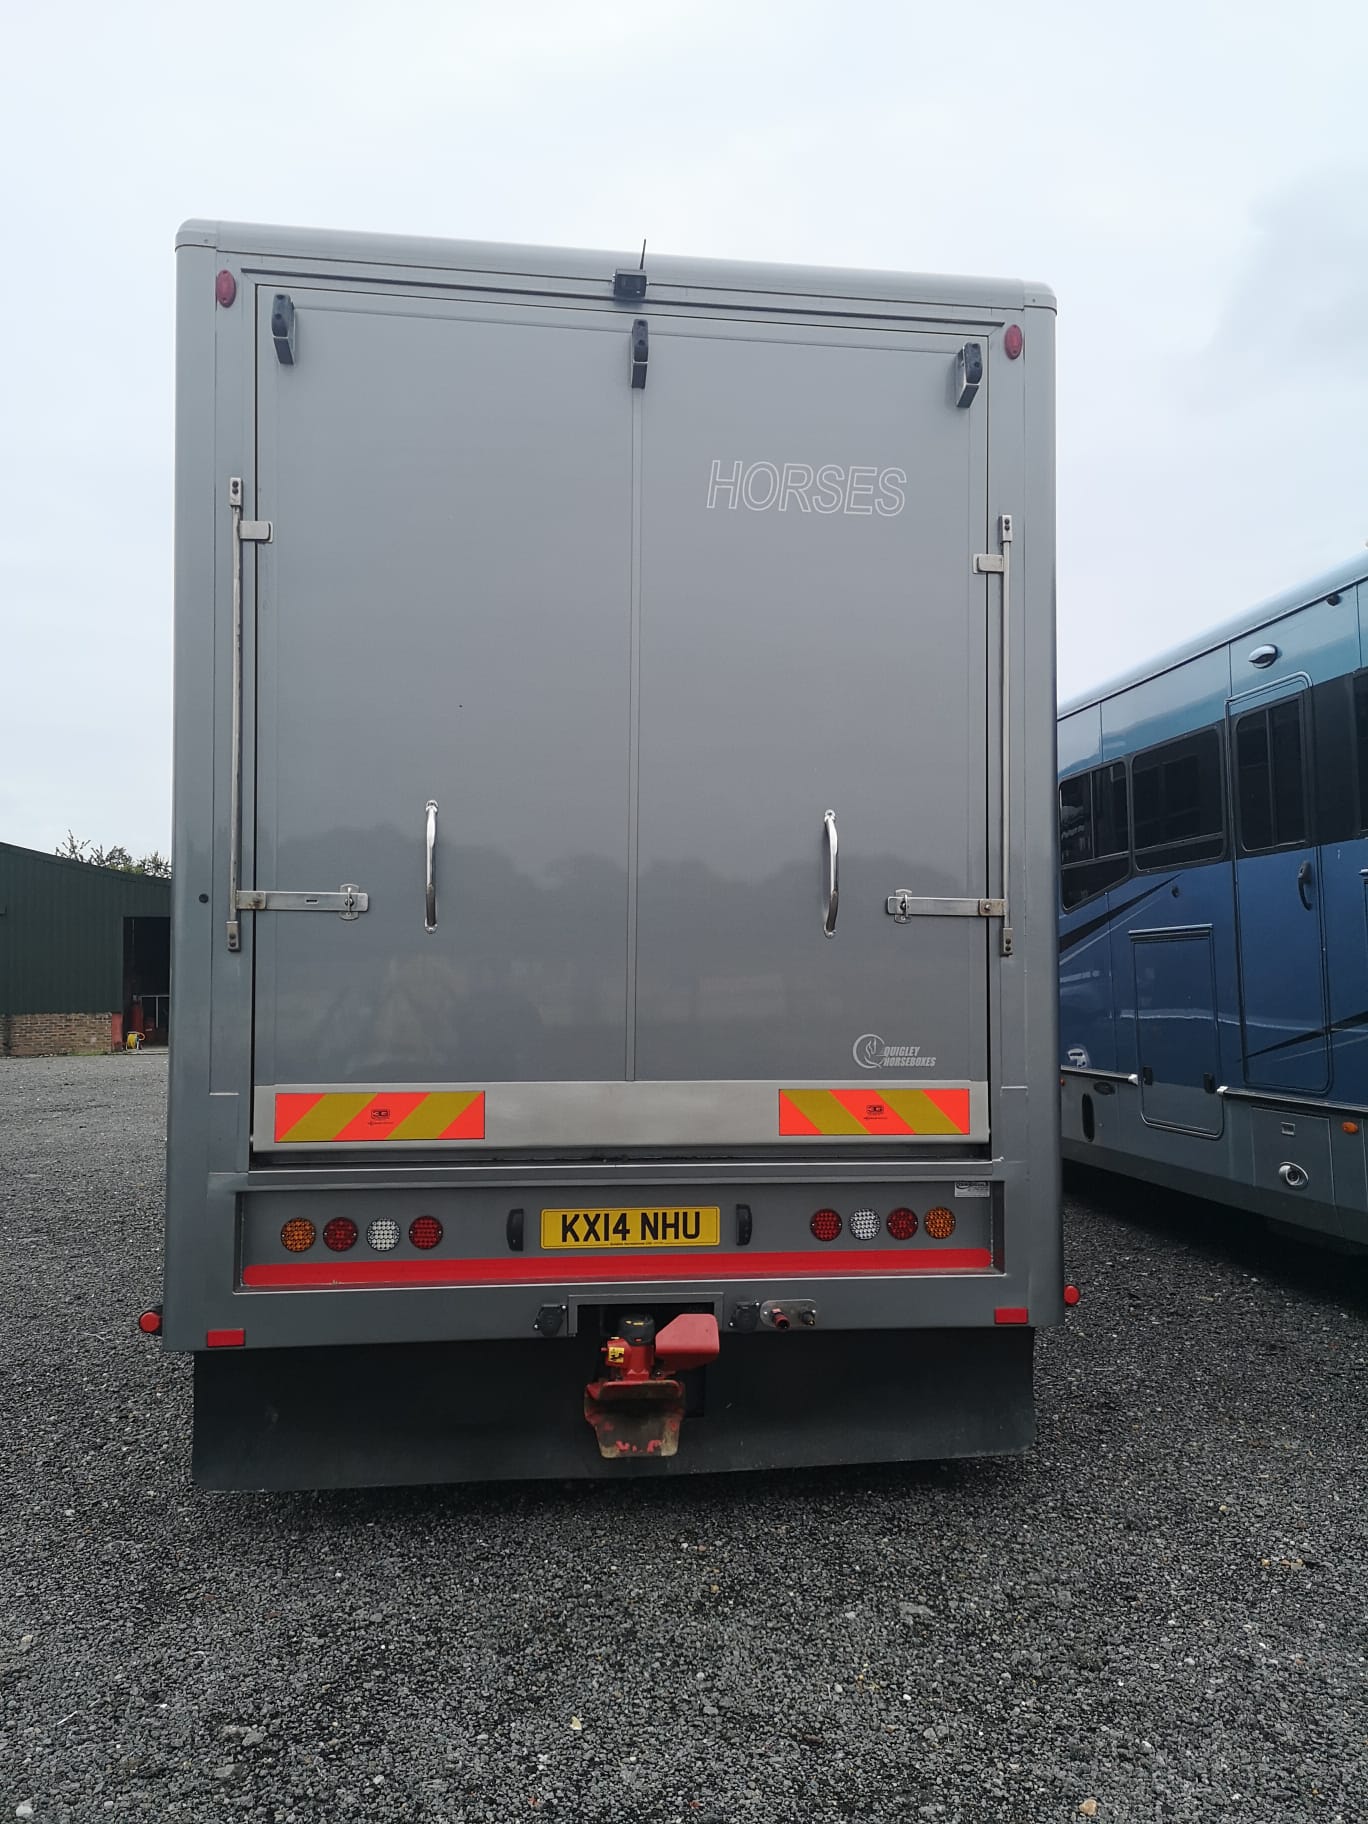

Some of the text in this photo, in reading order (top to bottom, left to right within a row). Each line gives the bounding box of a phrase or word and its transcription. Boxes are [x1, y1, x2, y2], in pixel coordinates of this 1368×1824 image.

[706, 459, 908, 517] HORSES
[882, 1046, 921, 1057] QUIGLEY
[882, 1057, 937, 1067] HORSEBOXES
[561, 1211, 701, 1243] KX14 NHU
